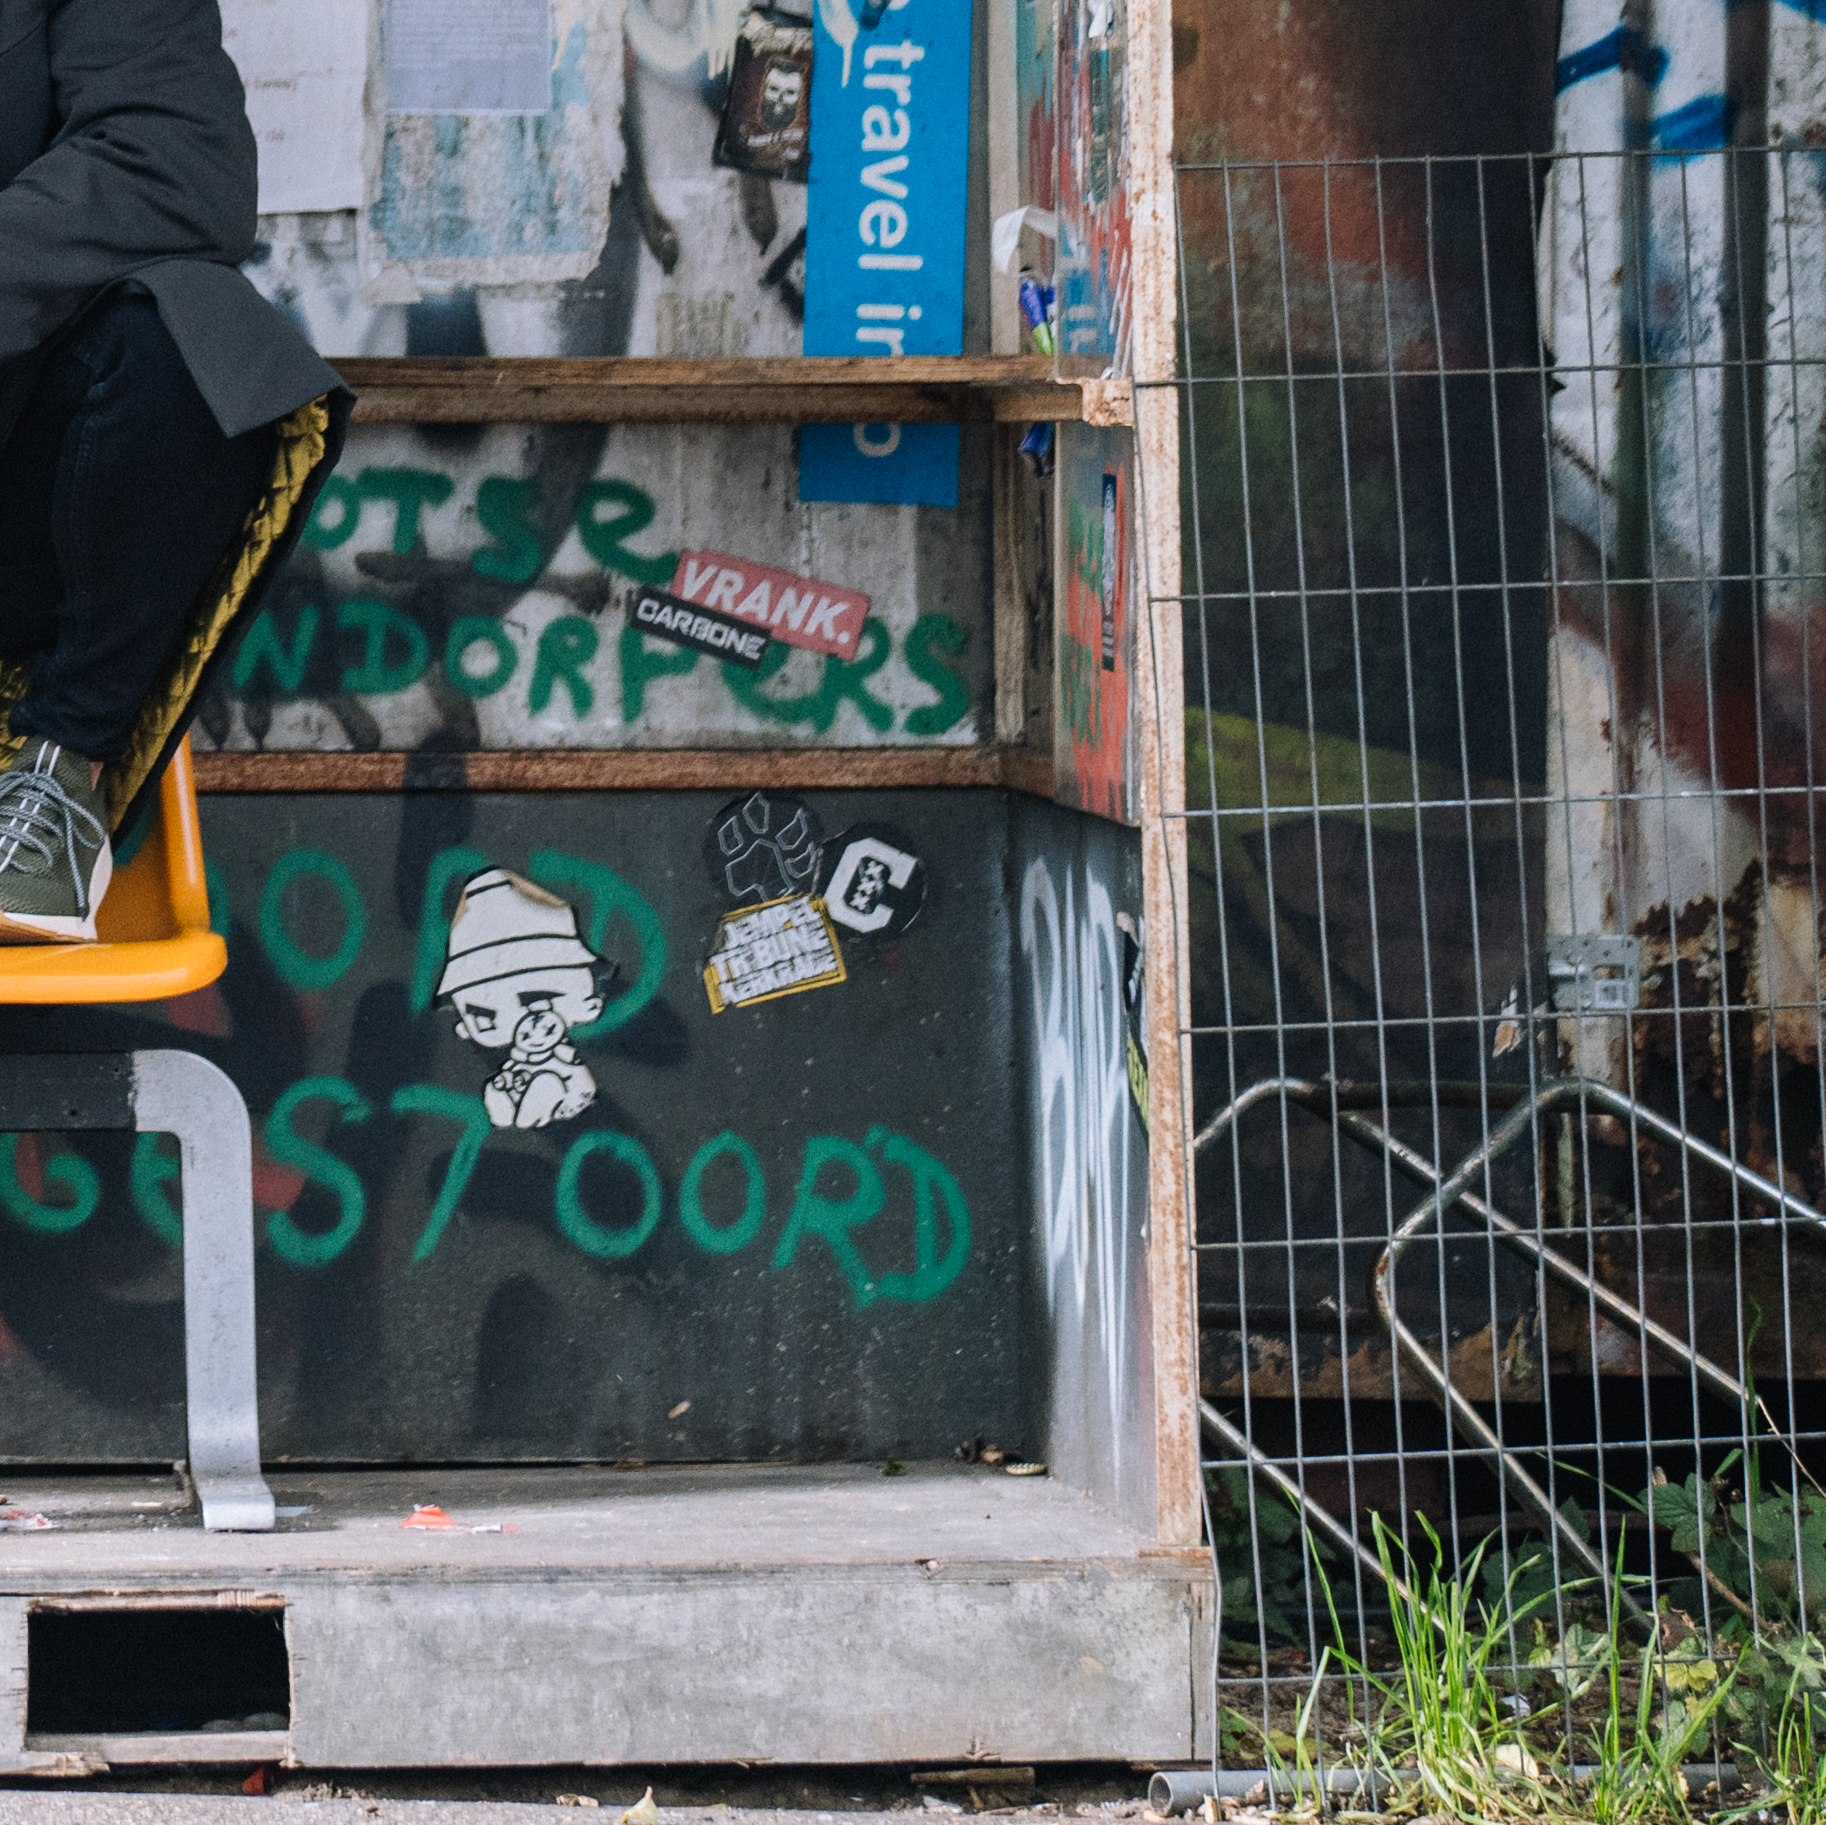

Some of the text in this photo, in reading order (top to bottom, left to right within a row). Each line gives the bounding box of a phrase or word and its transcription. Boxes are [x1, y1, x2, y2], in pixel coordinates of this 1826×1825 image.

[858, 45, 926, 272] travel
[637, 595, 767, 662] CARBONE
[677, 555, 854, 646] VRANK.
